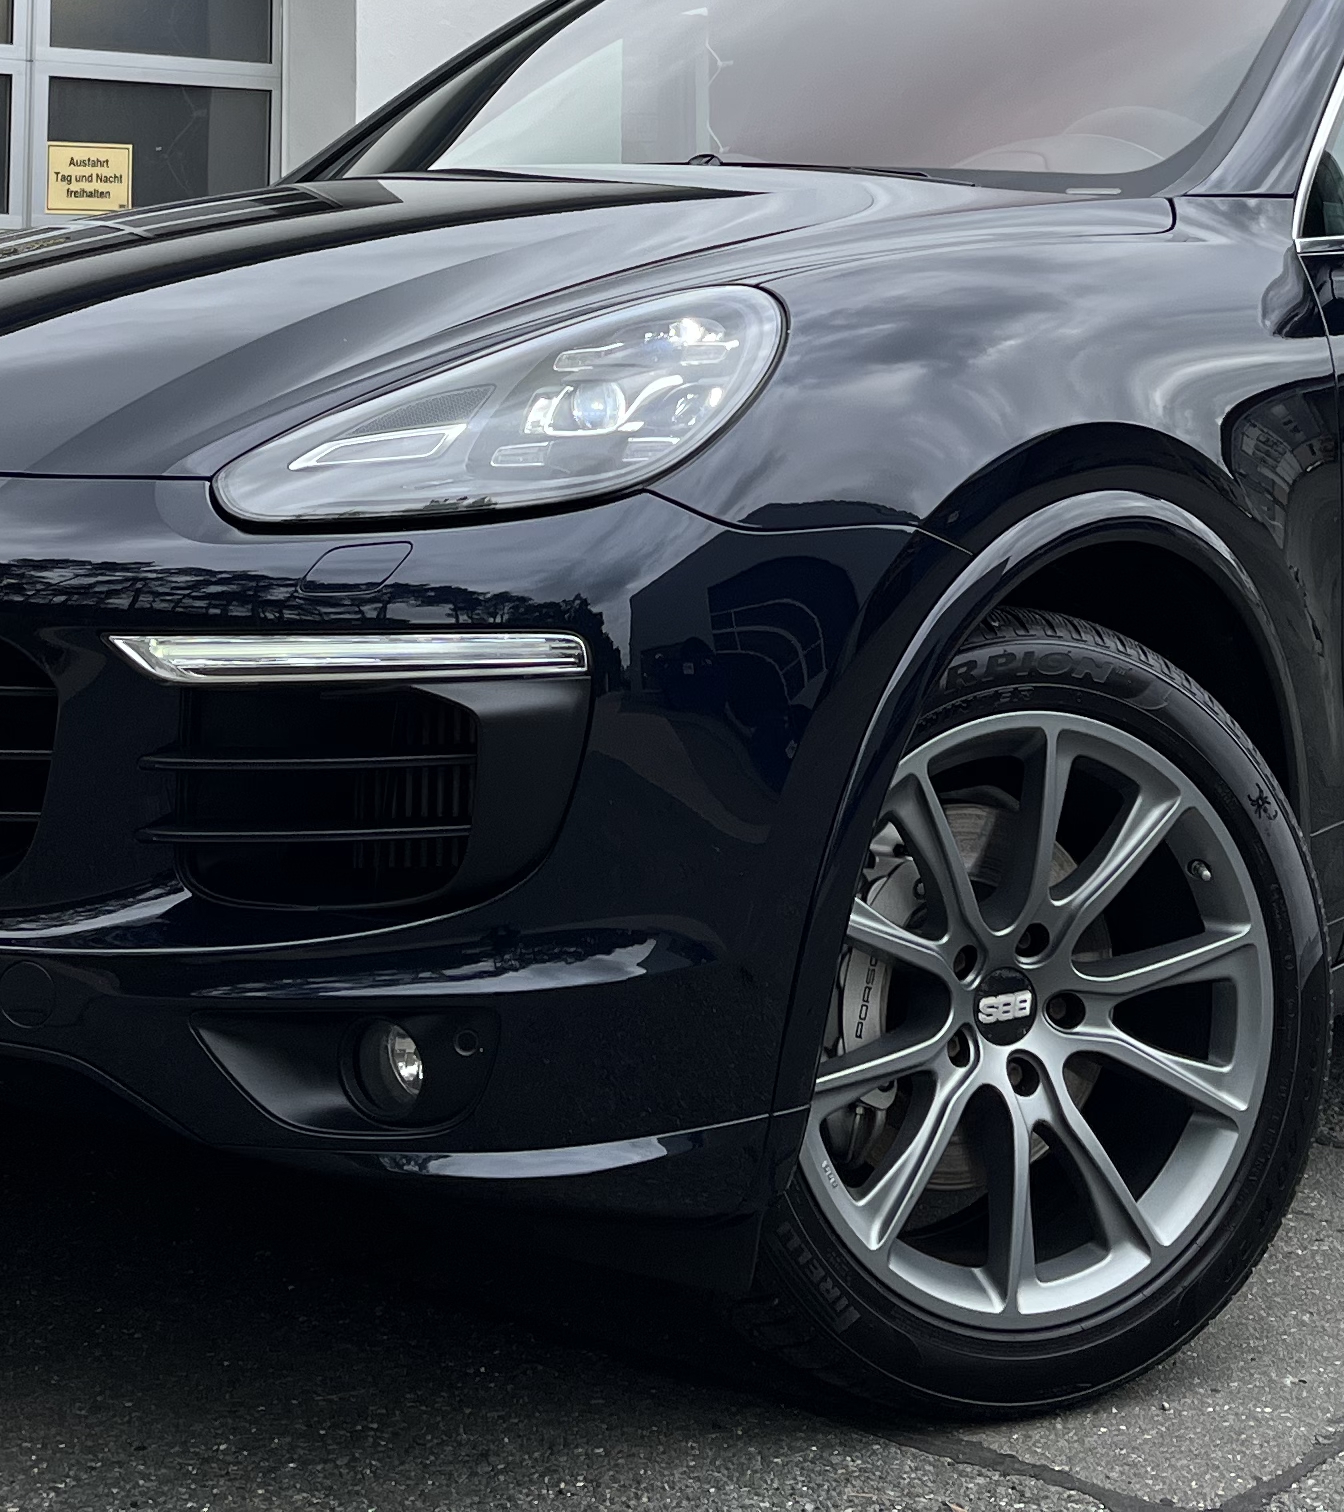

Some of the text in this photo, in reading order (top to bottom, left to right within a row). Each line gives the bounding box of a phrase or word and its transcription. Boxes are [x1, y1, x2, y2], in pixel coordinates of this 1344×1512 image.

[68, 156, 110, 168] Ausfahrt
[53, 171, 123, 186] Tag und Nacht
[66, 188, 111, 199] freihalten
[944, 650, 1114, 695] RPION
[855, 955, 878, 1040] PORSC
[771, 1221, 861, 1334] PIRELLI
